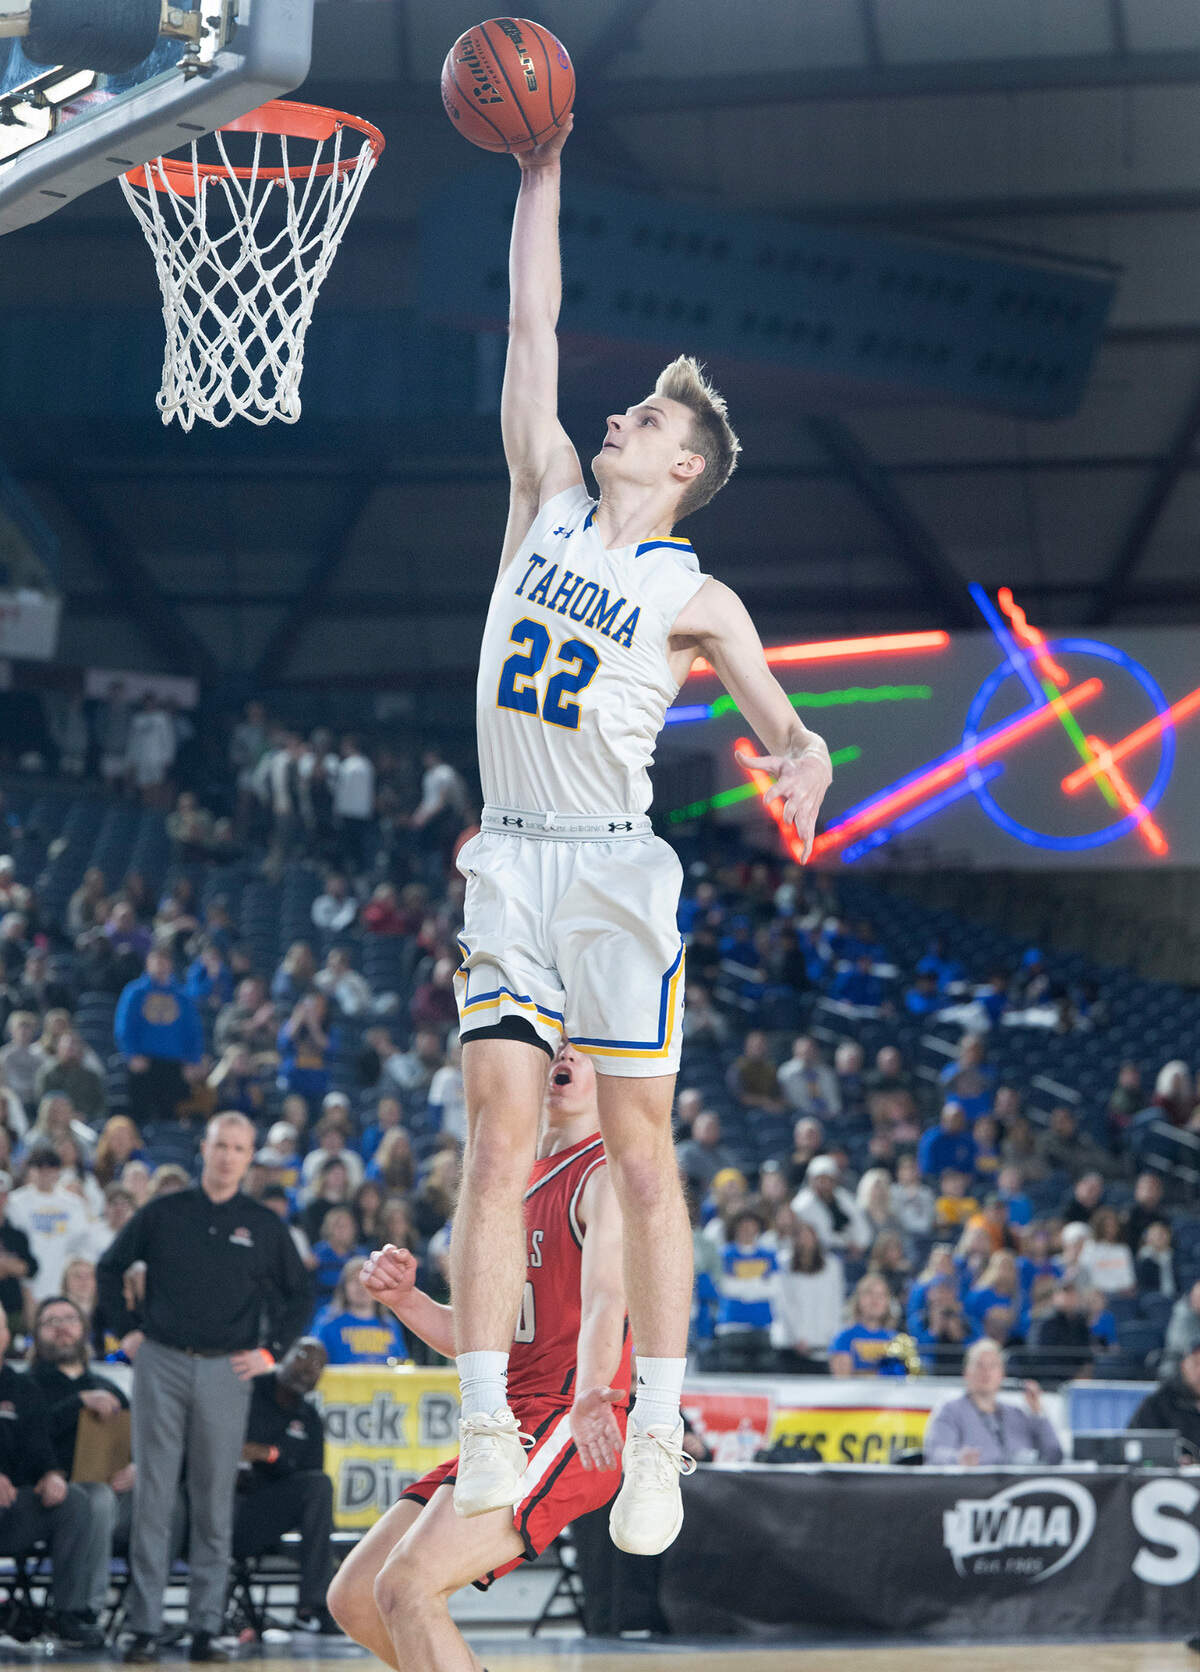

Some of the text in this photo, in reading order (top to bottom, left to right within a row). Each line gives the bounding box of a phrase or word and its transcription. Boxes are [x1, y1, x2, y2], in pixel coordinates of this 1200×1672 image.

[457, 35, 505, 105] Baden
[509, 35, 539, 92] ELITE
[514, 552, 642, 649] TAHOMA
[496, 616, 602, 732] 22
[322, 1389, 408, 1447] ack
[972, 1504, 1073, 1548] WIAA
